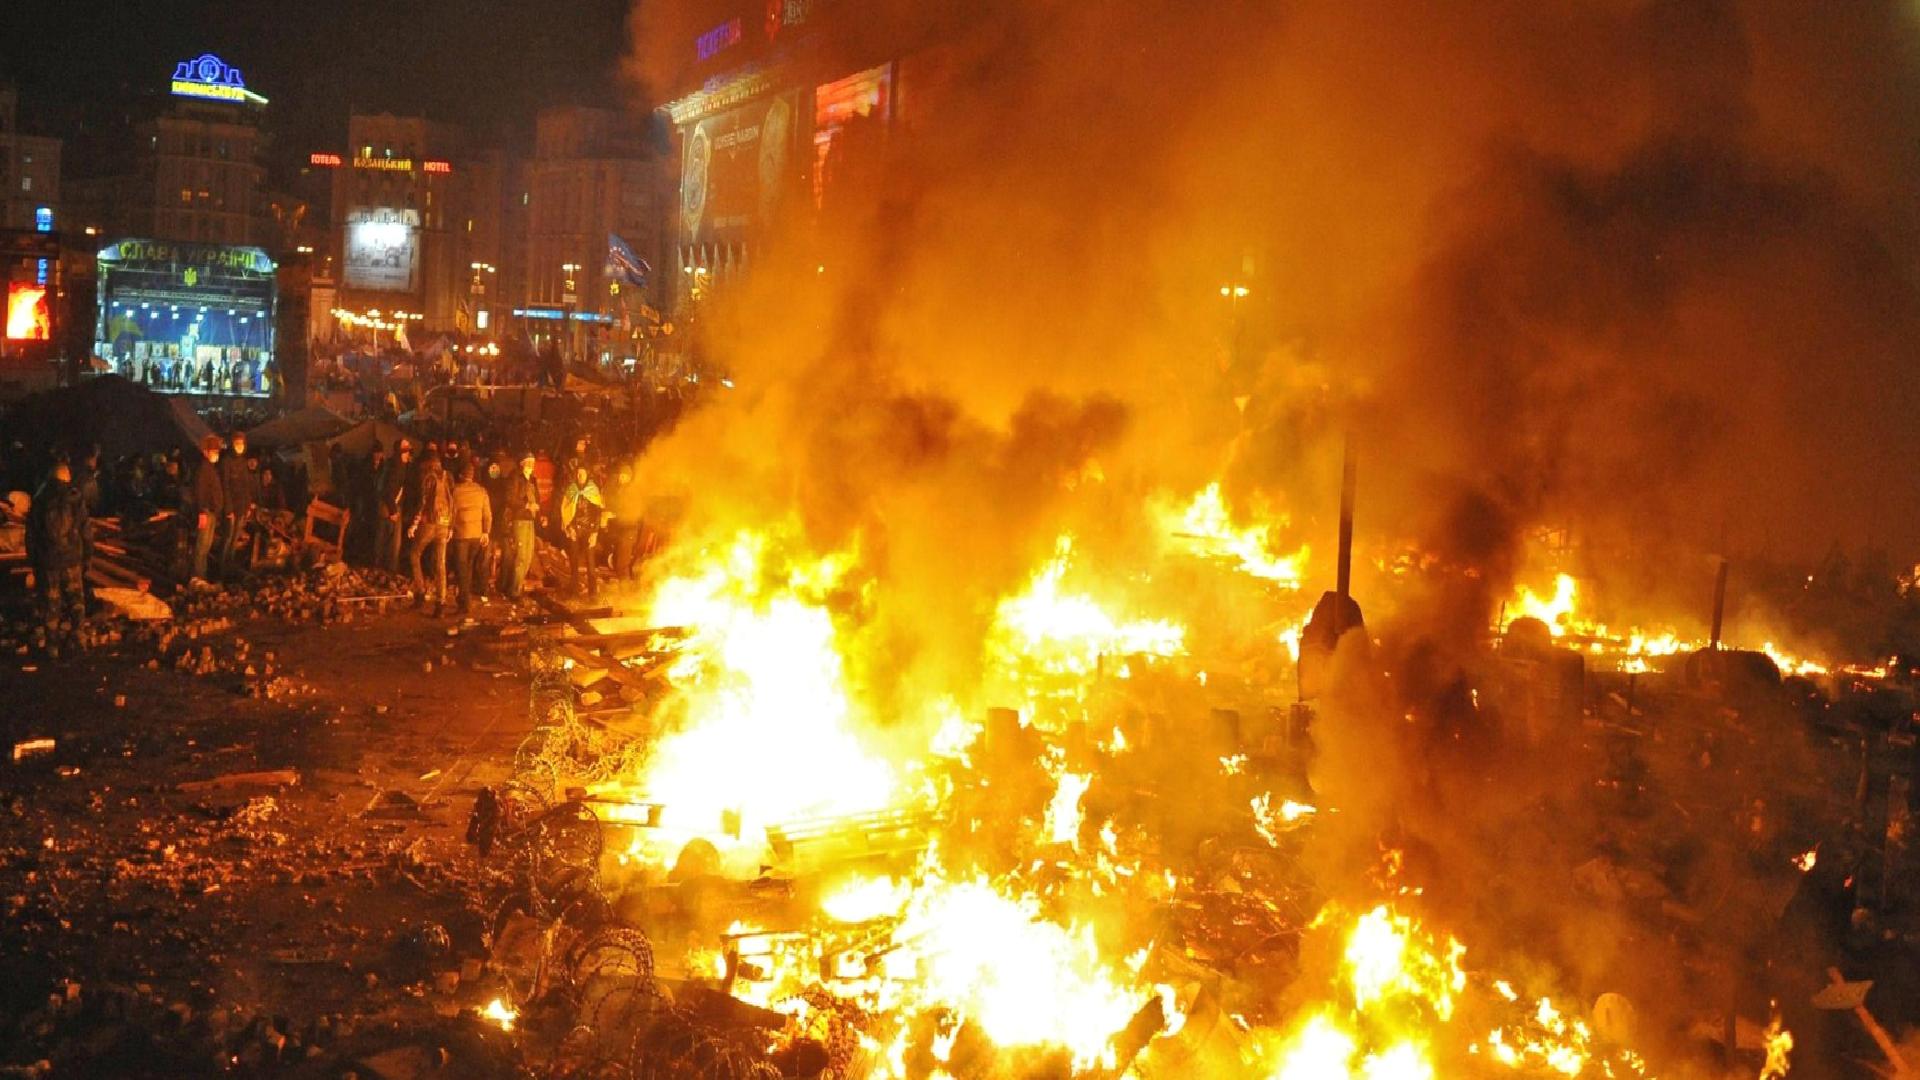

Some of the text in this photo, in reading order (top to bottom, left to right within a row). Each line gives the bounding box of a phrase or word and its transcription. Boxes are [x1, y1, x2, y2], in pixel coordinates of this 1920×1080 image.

[311, 154, 341, 166] ГОТЕЛЬ
[424, 161, 451, 172] HOTEL
[119, 241, 179, 262] СЛАВА
